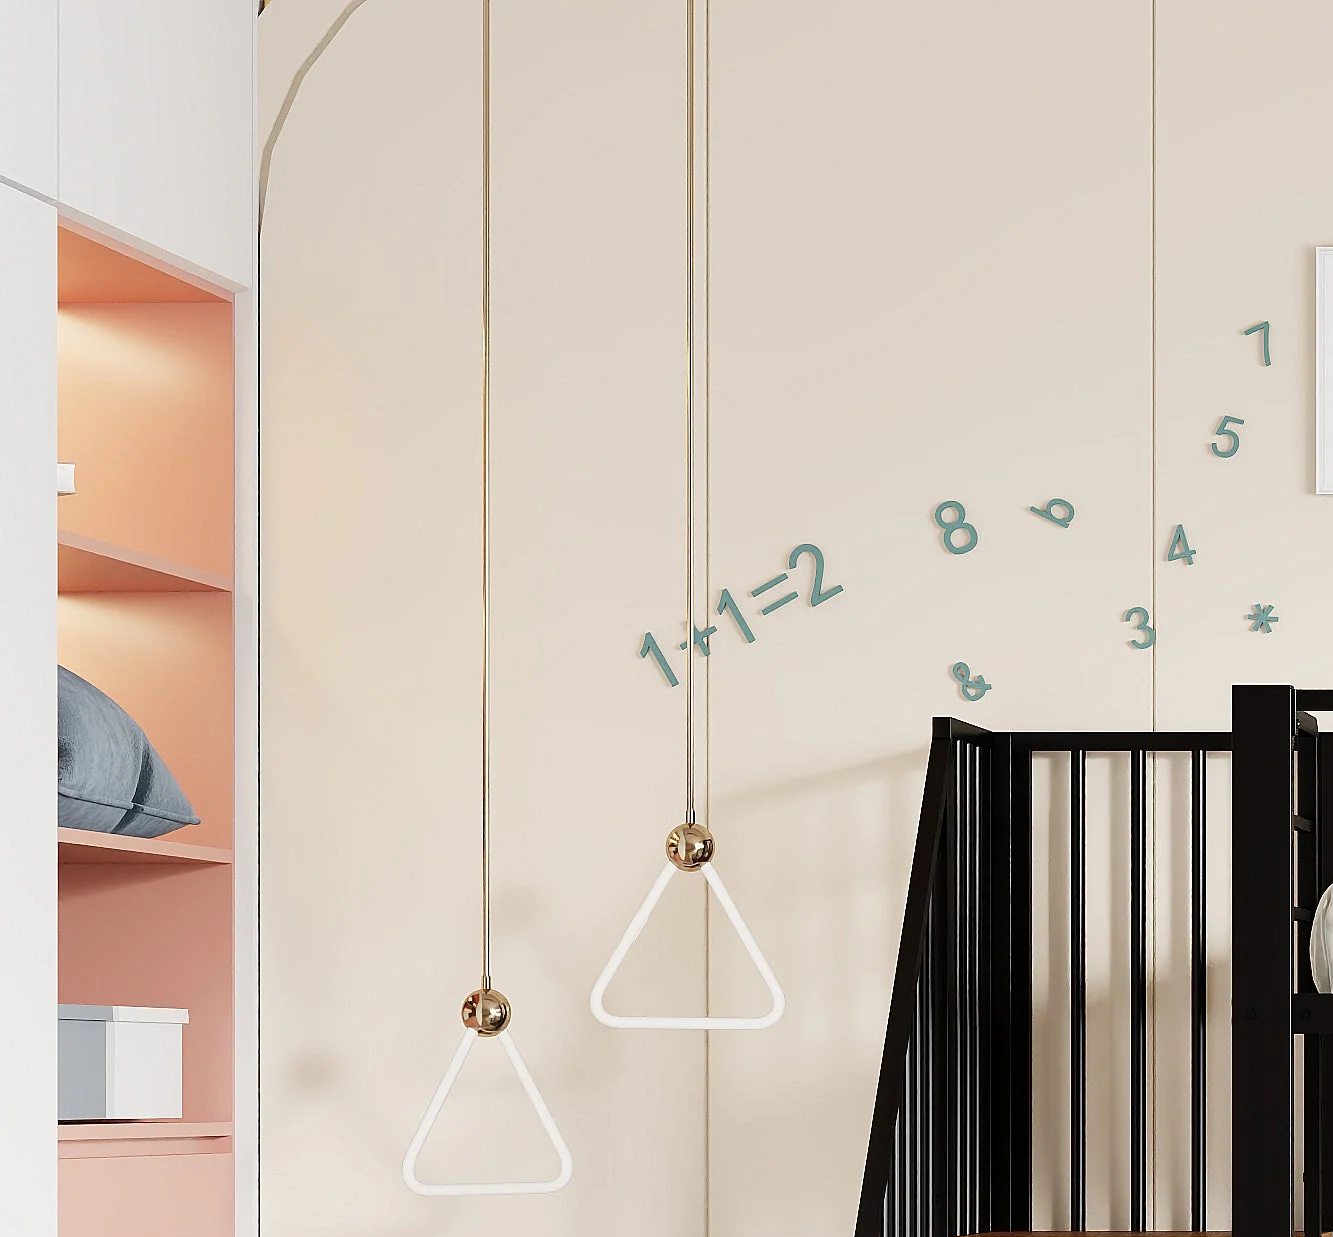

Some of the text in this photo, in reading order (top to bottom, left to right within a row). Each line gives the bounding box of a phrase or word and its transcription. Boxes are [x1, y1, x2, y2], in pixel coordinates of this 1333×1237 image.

[1243, 321, 1271, 367] 7
[1211, 415, 1245, 459] 5
[934, 500, 978, 555] 8
[1166, 524, 1197, 566] 4
[1124, 606, 1155, 650] 3
